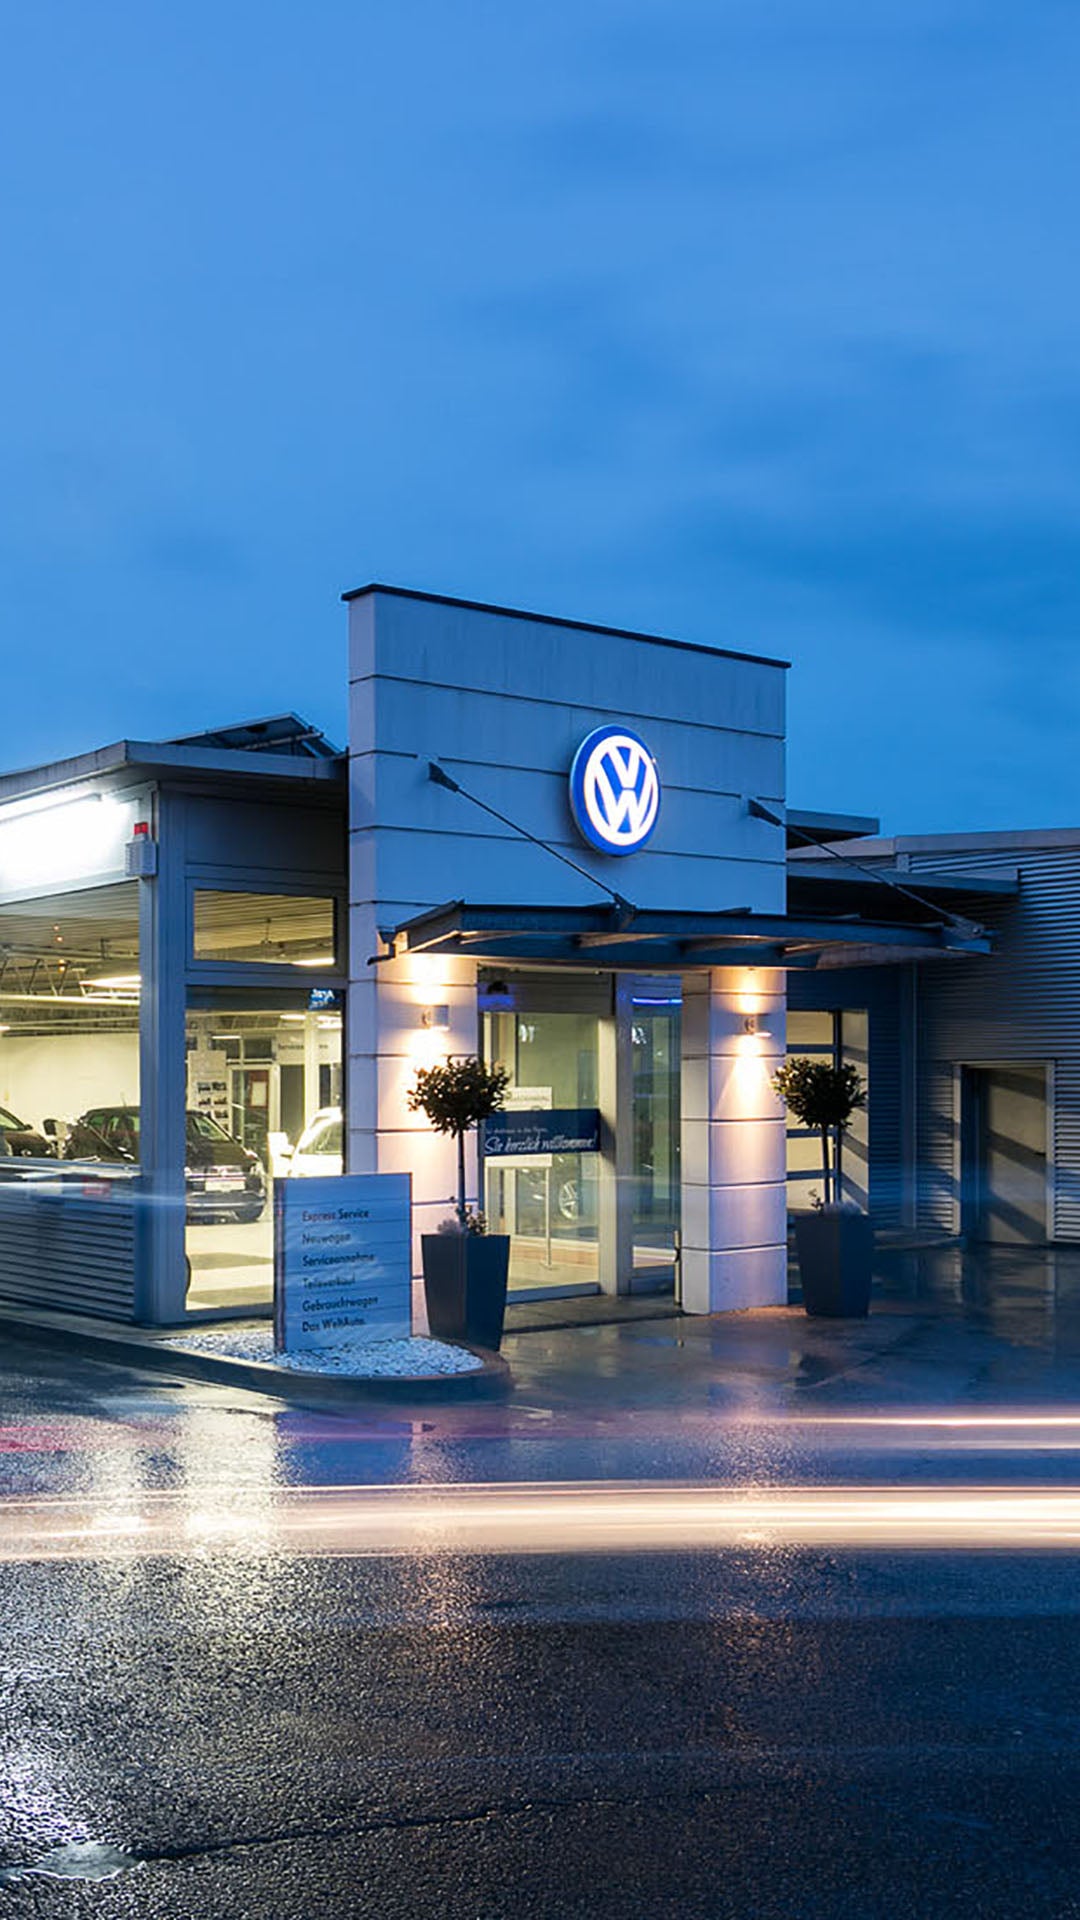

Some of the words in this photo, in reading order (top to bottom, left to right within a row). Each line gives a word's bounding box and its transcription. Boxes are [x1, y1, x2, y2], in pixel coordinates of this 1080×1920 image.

[583, 735, 659, 846] VW
[302, 1210, 336, 1222] Express
[338, 1208, 369, 1219] Service
[302, 1233, 351, 1245] Neuwagen
[302, 1252, 375, 1267] Serviceannahme
[302, 1296, 378, 1312] Gebrauchtwagen
[302, 1321, 320, 1332] Das
